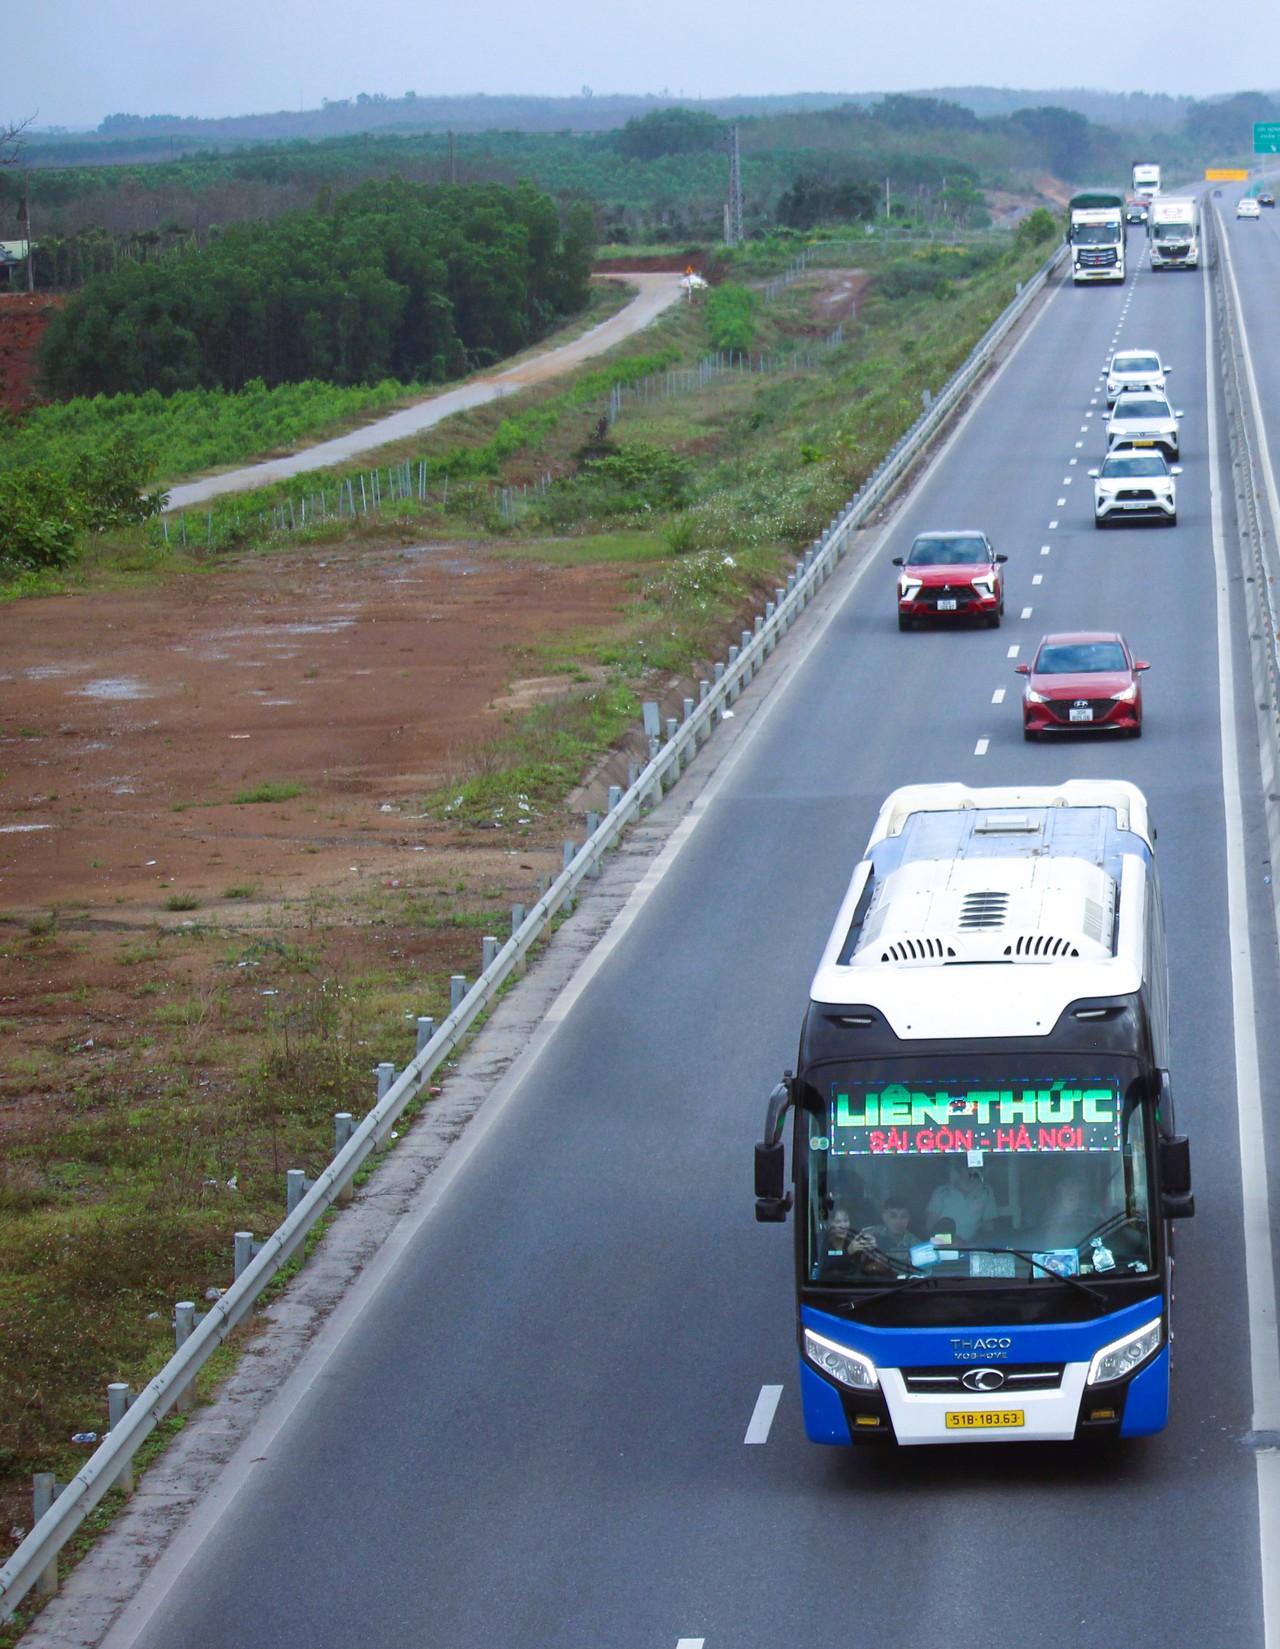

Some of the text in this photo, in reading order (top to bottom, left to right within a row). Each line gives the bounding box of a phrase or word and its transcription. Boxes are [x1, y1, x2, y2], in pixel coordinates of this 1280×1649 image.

[837, 1081, 1112, 1126] LIÊN THỨC
[916, 1125, 972, 1150] GÒN
[950, 1337, 1011, 1350] THACO
